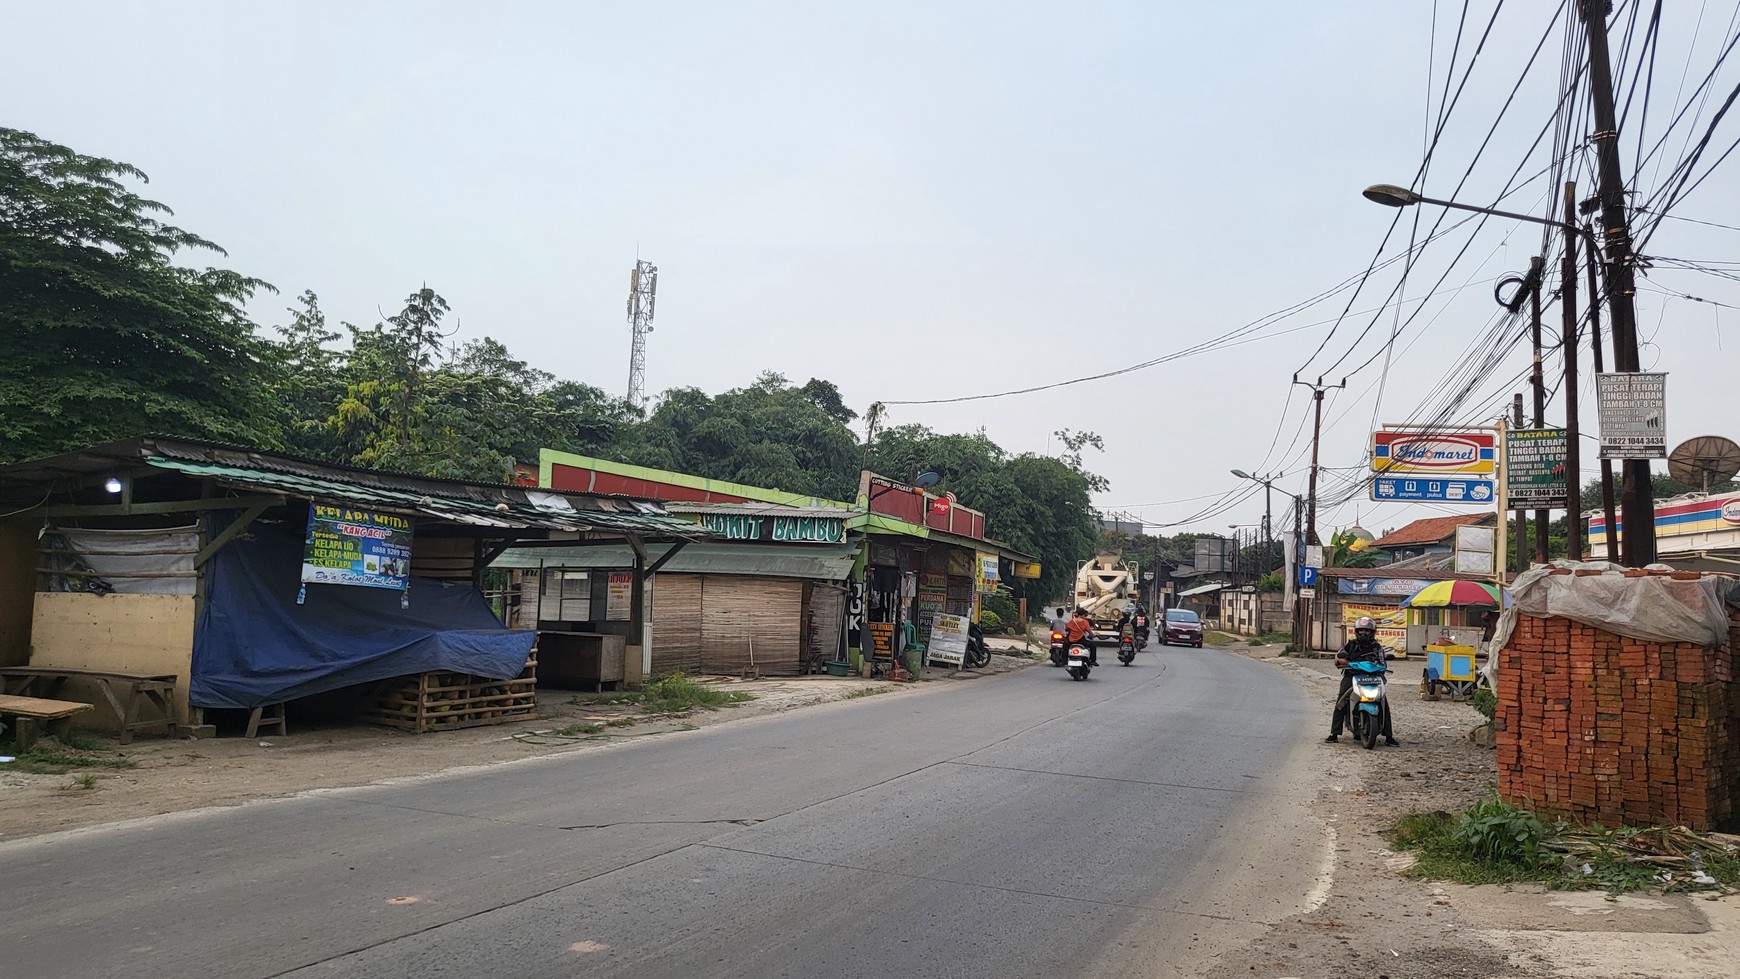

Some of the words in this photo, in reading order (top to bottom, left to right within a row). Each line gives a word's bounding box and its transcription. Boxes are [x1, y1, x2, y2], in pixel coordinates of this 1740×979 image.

[1602, 384, 1629, 392] PUSAT
[1631, 383, 1663, 391] TERAPI
[1602, 392, 1632, 400] TINGGI
[1633, 391, 1662, 400] BADAN
[1602, 400, 1635, 408] TAMBAH
[1516, 431, 1558, 439] BATARA
[1537, 438, 1567, 446] TERAPI
[1608, 437, 1626, 445] 0822
[1628, 437, 1644, 445] 1044
[1396, 445, 1474, 460] Indomaret
[1509, 447, 1537, 455] TINGGI
[1538, 446, 1567, 454] BADAN
[1509, 454, 1540, 462] TAMBAH
[1514, 489, 1533, 497] 0822
[1534, 489, 1550, 497] 1044
[772, 516, 842, 542] BAMBU
[314, 539, 342, 550] KELAPA
[314, 549, 343, 559] KELAPA
[344, 551, 362, 560] MUDA
[313, 559, 324, 568] ES
[325, 560, 352, 569] KELAPA
[1304, 569, 1312, 583] P
